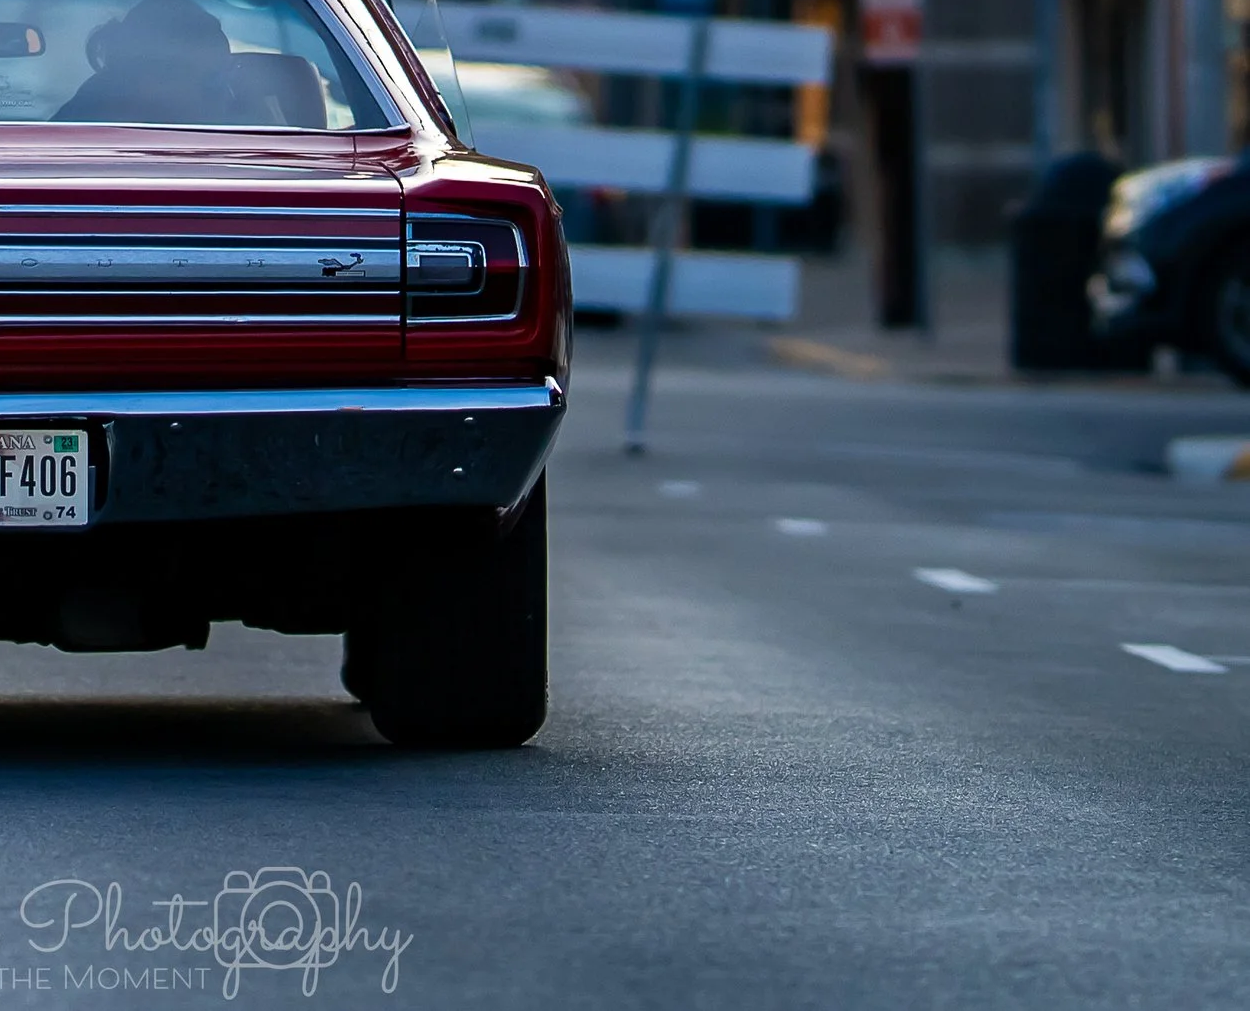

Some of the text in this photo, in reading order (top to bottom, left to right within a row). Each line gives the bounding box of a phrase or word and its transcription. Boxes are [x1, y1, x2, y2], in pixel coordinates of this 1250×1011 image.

[61, 437, 73, 448] 23
[5, 506, 37, 517] TRUST
[55, 506, 76, 518] 74
